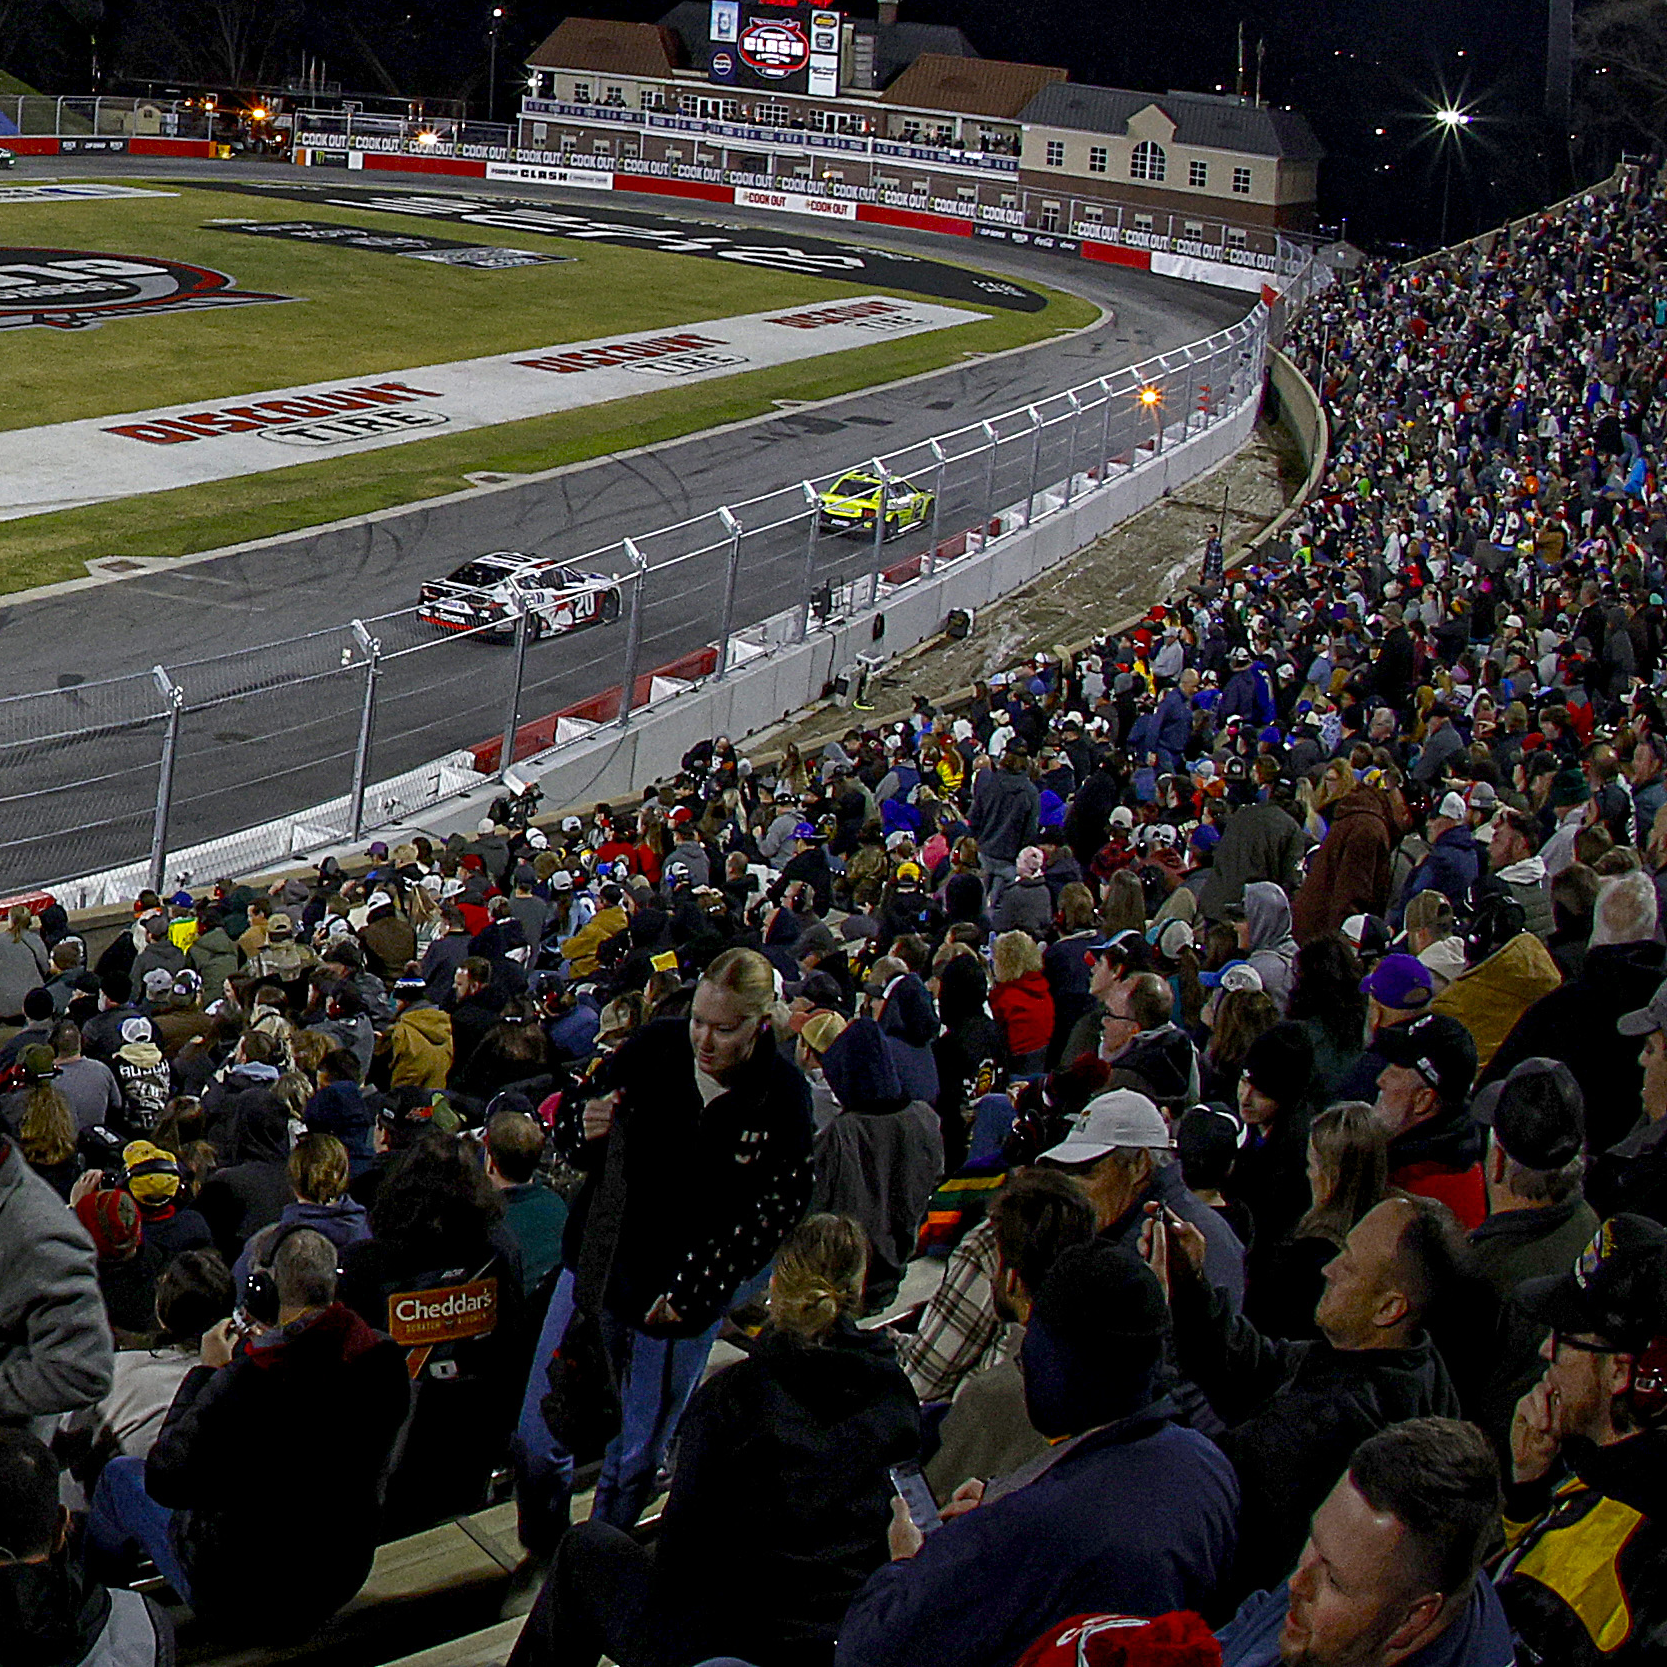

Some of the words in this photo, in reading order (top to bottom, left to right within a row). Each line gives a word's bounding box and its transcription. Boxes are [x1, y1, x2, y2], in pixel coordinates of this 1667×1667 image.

[743, 36, 804, 56] CLASH
[302, 134, 330, 145] COOK
[331, 136, 347, 147] OUT
[356, 136, 381, 148] COOK
[382, 138, 399, 150] OUT
[436, 142, 454, 155] OUT
[463, 144, 487, 158] COOK
[489, 146, 507, 160] OUT
[517, 148, 542, 162] COOK
[543, 151, 561, 164] OUT
[571, 153, 596, 167] COOK
[597, 155, 615, 169] OUT
[520, 169, 568, 181] CLASH
[624, 158, 649, 172] COOK
[651, 161, 668, 175] OUT
[678, 164, 702, 179] COOK
[704, 167, 721, 181] OUT
[730, 170, 754, 185] COOK
[756, 173, 773, 188] OUT
[781, 177, 807, 191] COOK
[808, 180, 824, 194] OUT
[833, 183, 857, 198] COOK
[859, 186, 876, 200] OUT
[884, 191, 907, 206] COOK
[909, 195, 927, 209] OUT
[934, 198, 957, 214] COOK
[958, 202, 976, 216] OUT
[983, 205, 1006, 221] COOK
[1007, 211, 1024, 224] OUT
[1078, 222, 1100, 238] COOK
[1101, 227, 1117, 241] OUT
[1126, 230, 1149, 247] COOK
[1151, 235, 1169, 250] OUT
[1176, 238, 1201, 256] COOK
[1203, 244, 1221, 259] OUT
[1230, 249, 1256, 266] COOK
[1258, 254, 1275, 270] OUT
[510, 332, 733, 376] DISCOUNT
[637, 350, 739, 376] TIRE
[101, 381, 444, 447] DISCOUNT
[273, 409, 430, 443] TIRE
[575, 594, 597, 618] 20
[395, 1287, 493, 1322] Cheddar's
